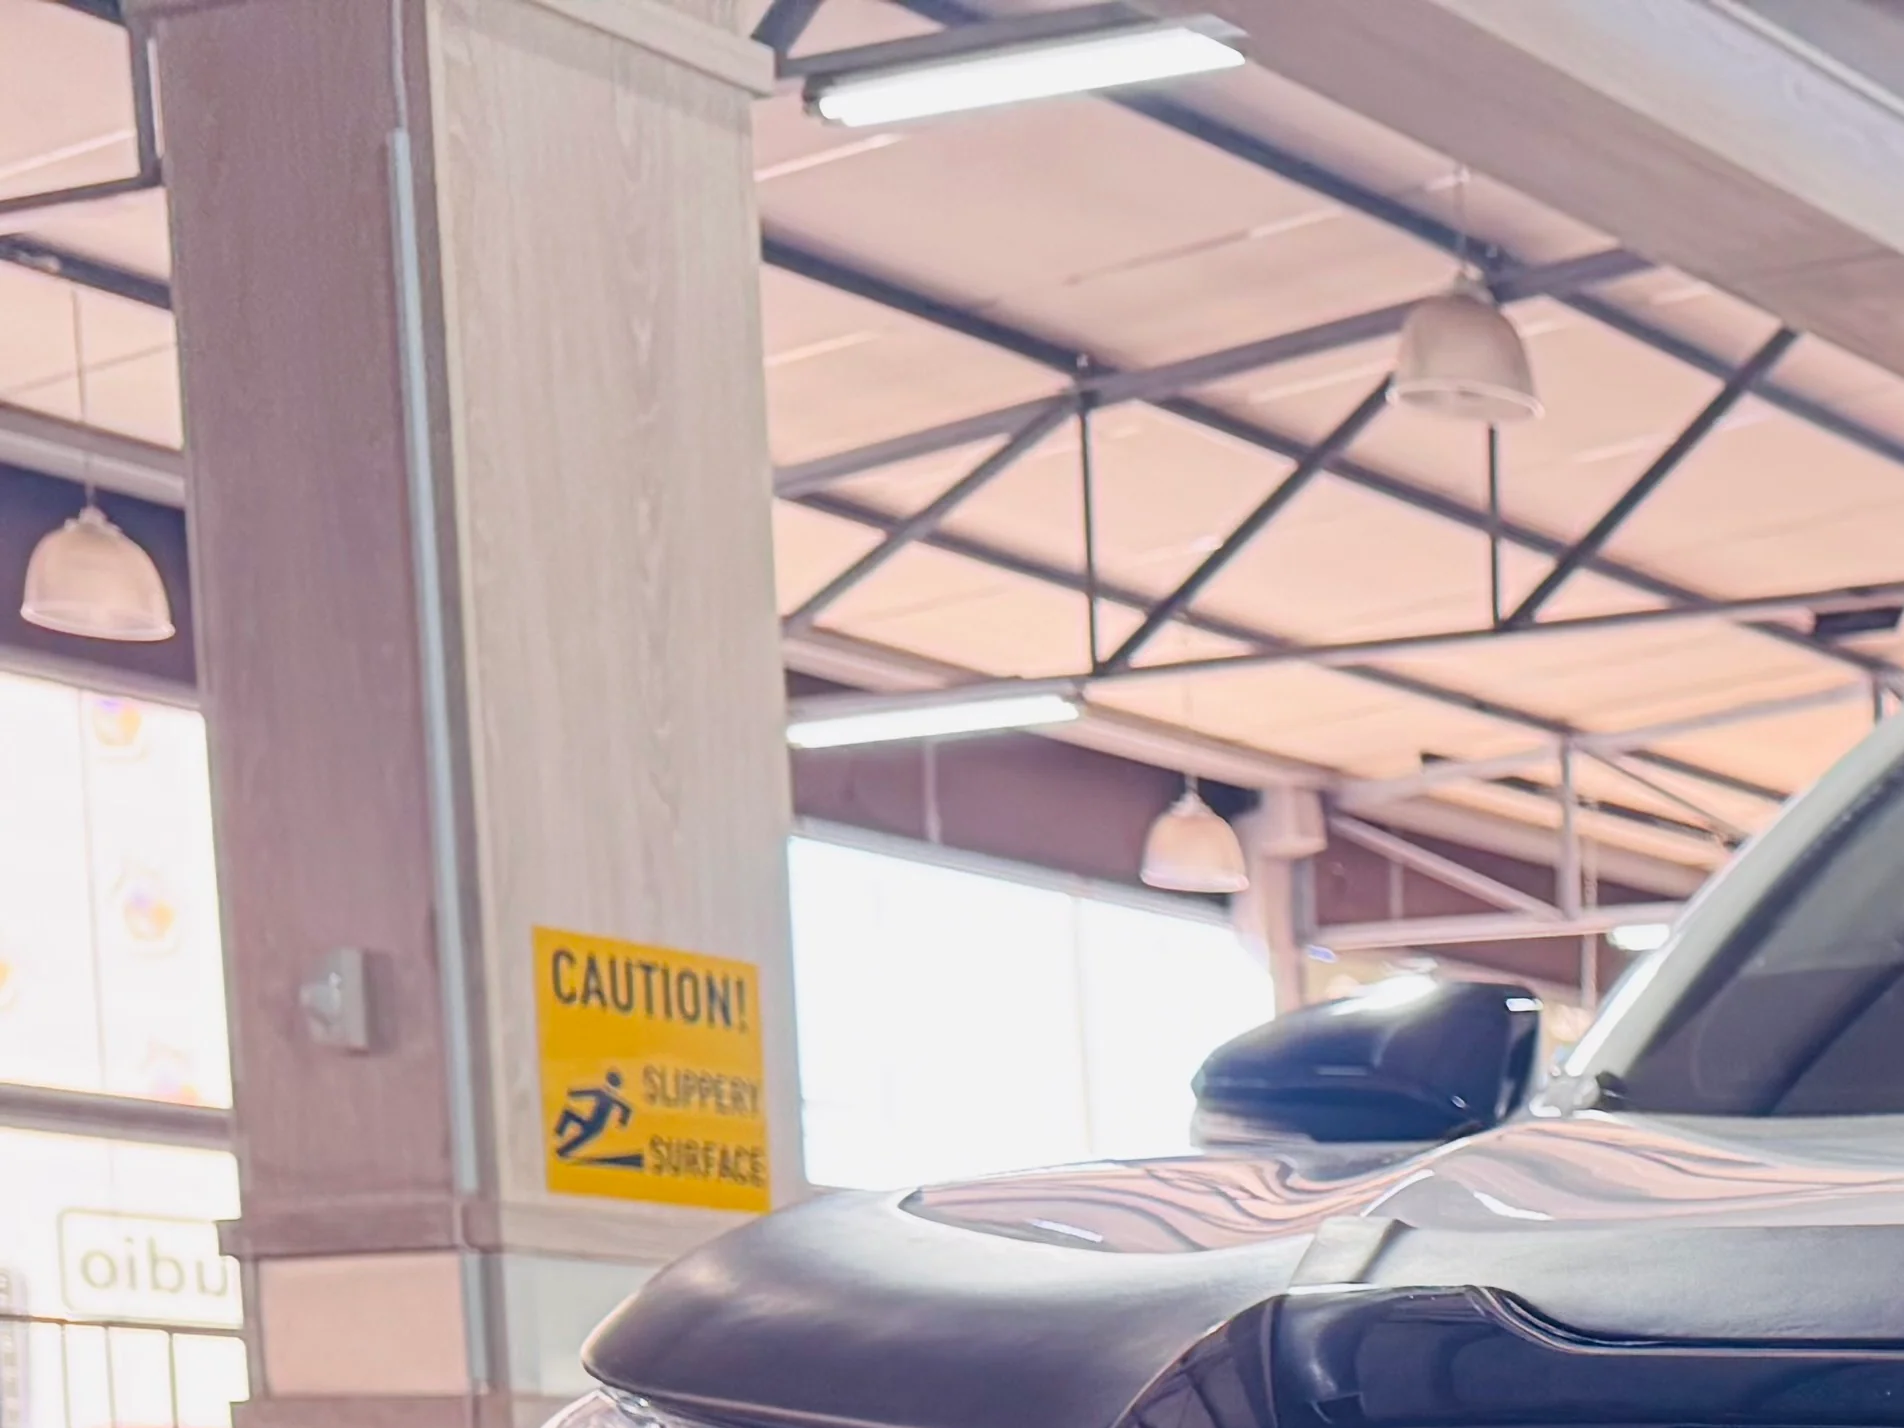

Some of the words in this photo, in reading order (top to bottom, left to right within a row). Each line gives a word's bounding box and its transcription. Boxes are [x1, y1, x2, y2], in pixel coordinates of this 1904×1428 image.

[551, 948, 747, 1032] CAUTION!
[642, 1064, 759, 1118] SLIPPERY
[649, 1134, 765, 1187] SURFACE
